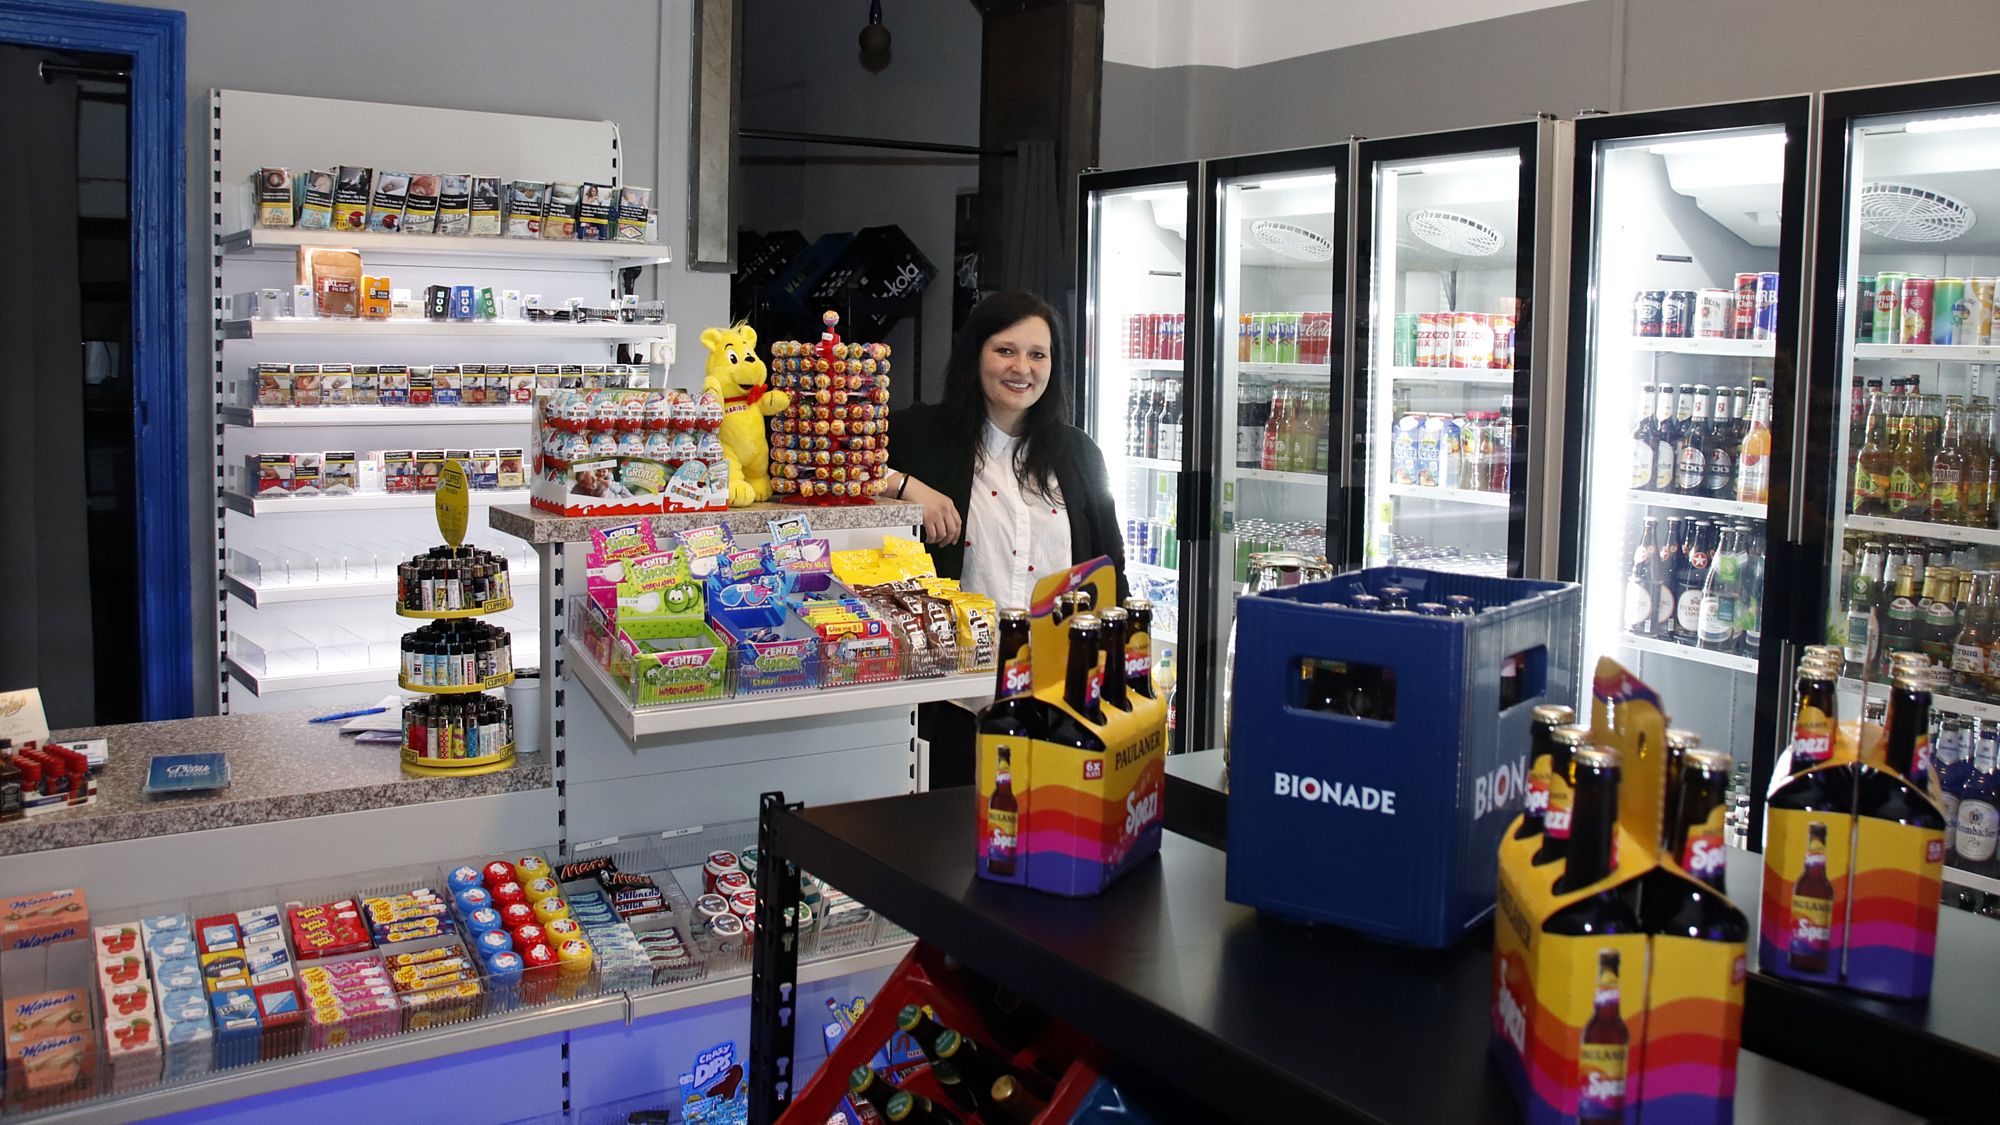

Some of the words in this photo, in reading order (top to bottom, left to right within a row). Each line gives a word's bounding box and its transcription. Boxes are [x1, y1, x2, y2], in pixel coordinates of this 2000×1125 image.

[435, 290, 445, 313] OCB
[460, 289, 470, 314] OCB
[484, 292, 494, 313] OCB
[641, 556, 669, 568] CENTER
[734, 553, 757, 564] CENTER
[486, 601, 507, 611] CLIPPER
[667, 654, 704, 668] CENTER
[764, 647, 799, 658] CENTER
[487, 676, 507, 687] CLIPPER
[1115, 730, 1161, 771] PAULANER
[1274, 771, 1396, 815] BIONADE
[1473, 755, 1527, 821] BION
[1125, 782, 1158, 836] Spezi
[561, 858, 607, 880] Mars
[612, 872, 651, 884] Mars
[14, 927, 76, 950] Manner
[15, 992, 77, 1017] Manner
[18, 1034, 82, 1058] Manner
[699, 1044, 732, 1064] CRAZY
[694, 1051, 732, 1089] DIPS
